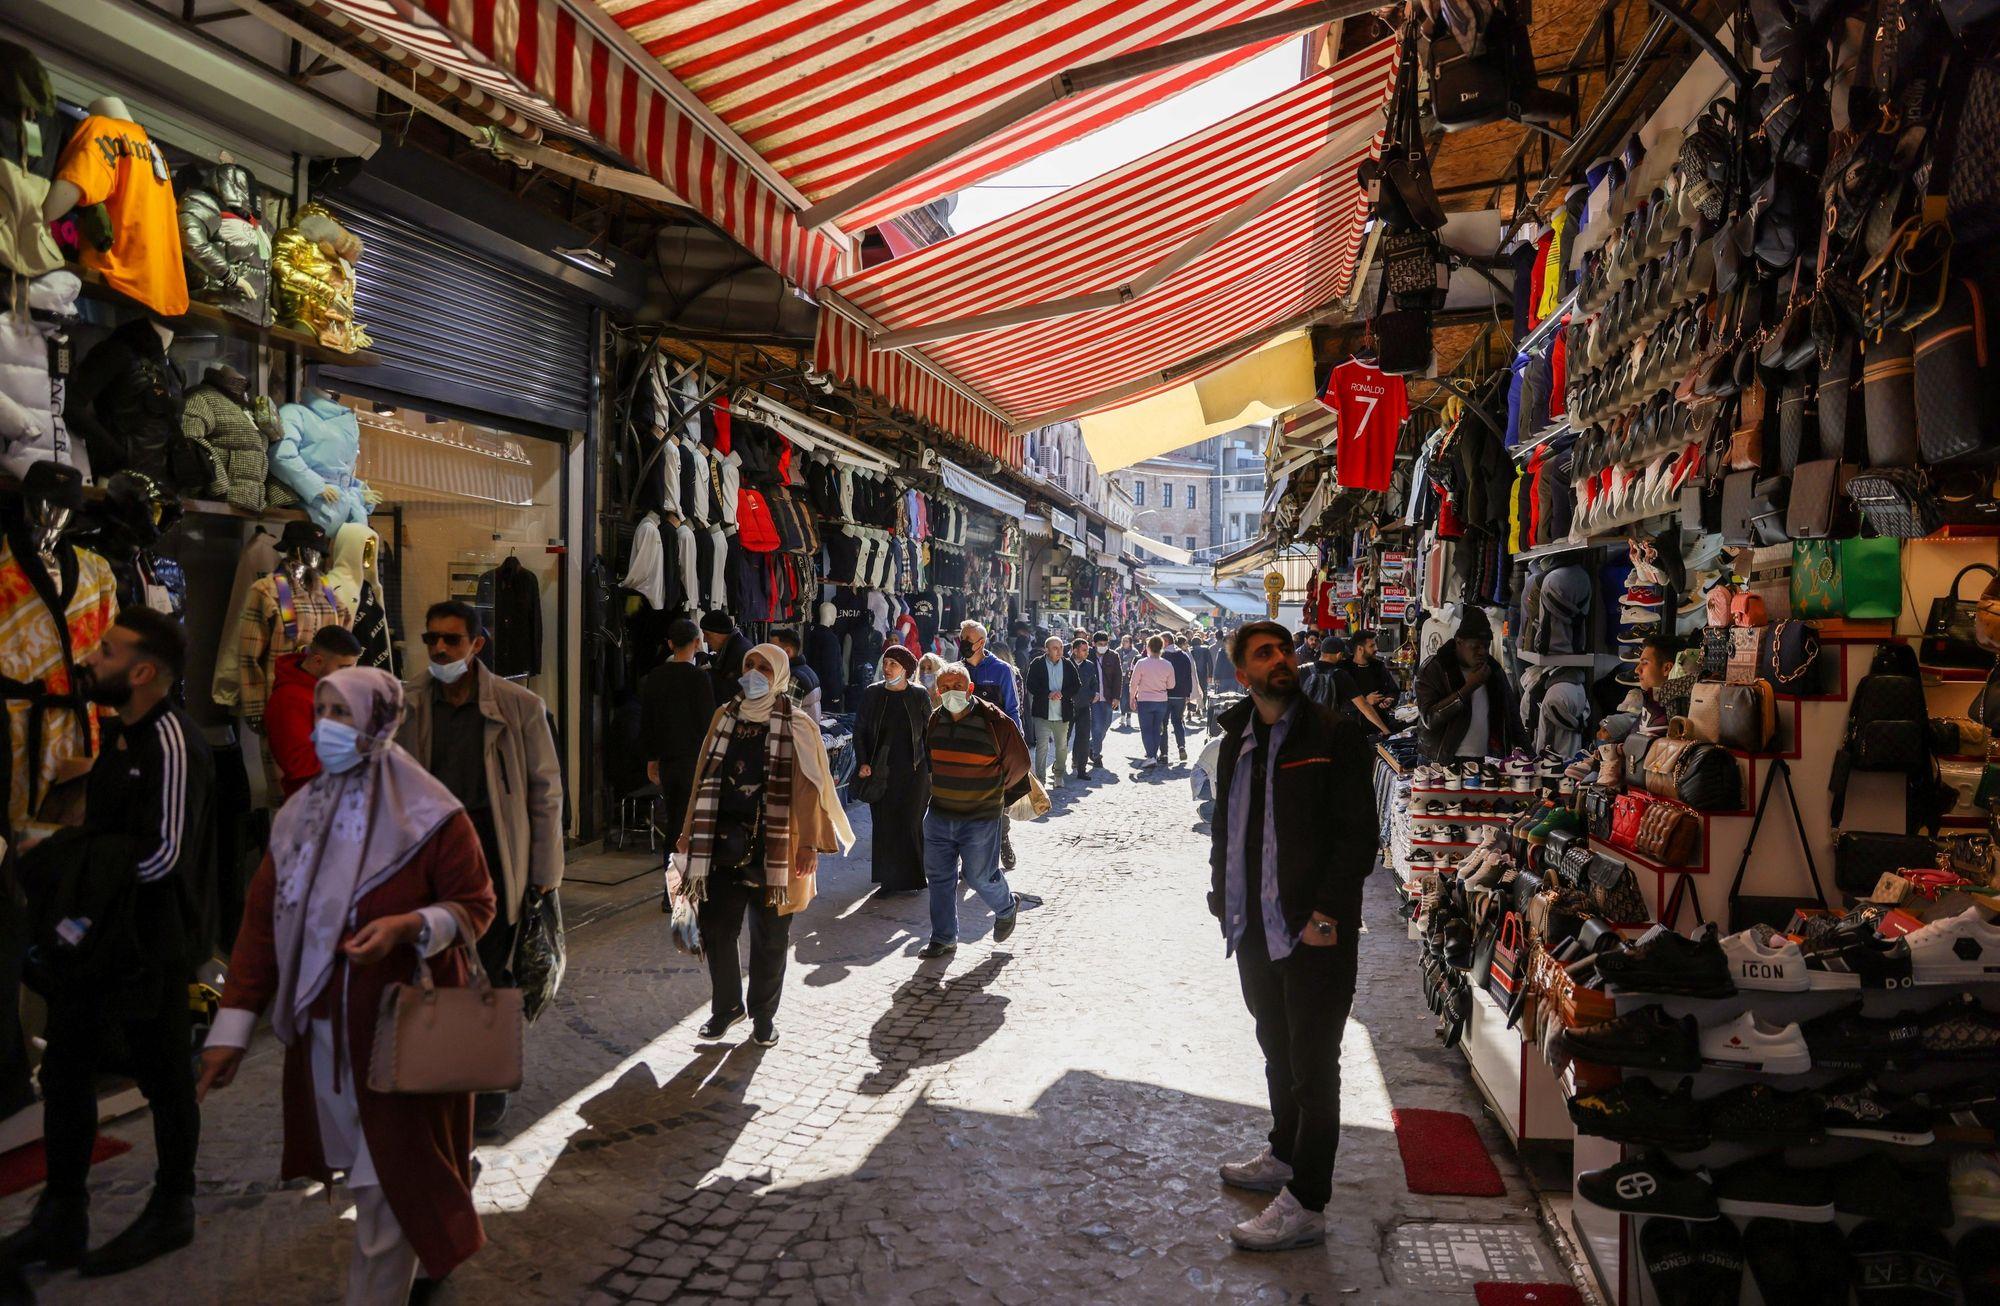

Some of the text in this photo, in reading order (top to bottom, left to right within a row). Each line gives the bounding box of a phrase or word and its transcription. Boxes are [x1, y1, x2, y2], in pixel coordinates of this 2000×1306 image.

[1461, 92, 1480, 102] Dior
[1351, 382, 1385, 395] RONALDO
[1353, 395, 1379, 440] 7
[1742, 964, 1784, 978] ICON
